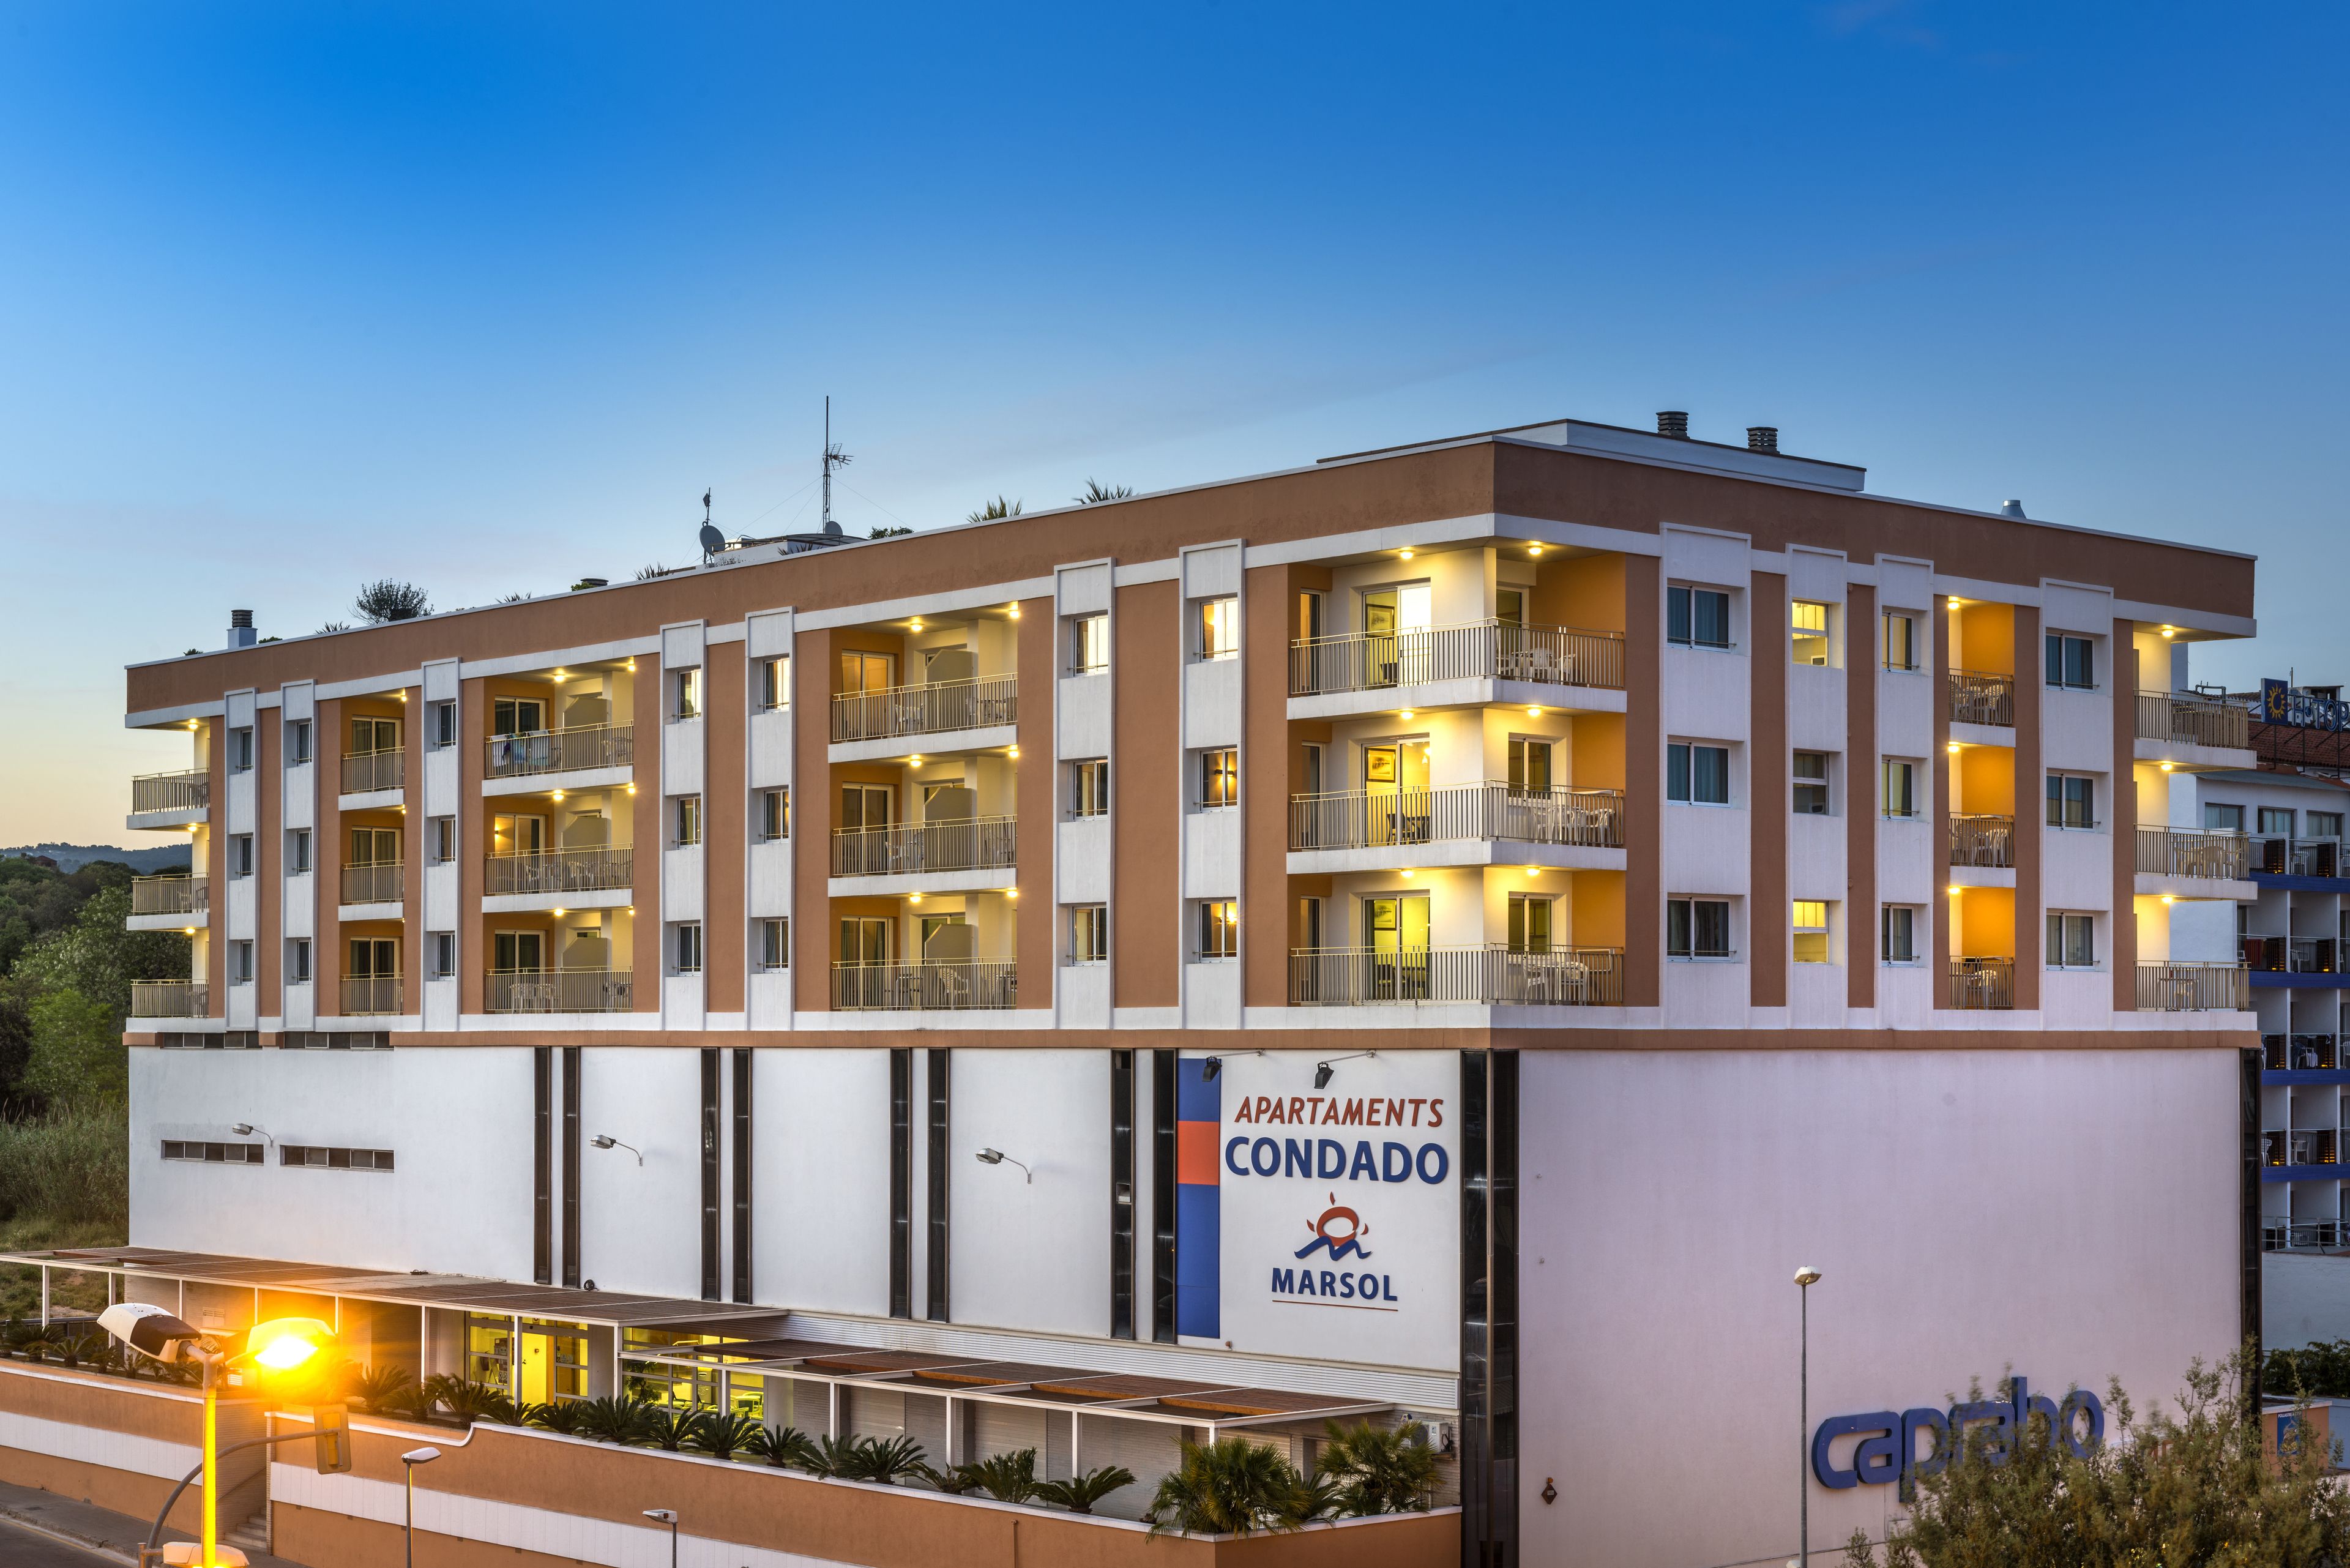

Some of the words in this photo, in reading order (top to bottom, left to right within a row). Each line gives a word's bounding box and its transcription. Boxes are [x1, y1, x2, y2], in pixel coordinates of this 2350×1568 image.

[1234, 1096, 1444, 1127] APARTAMENTS
[1225, 1136, 1449, 1184] CONDADO
[1272, 1267, 1398, 1301] MARSOL
